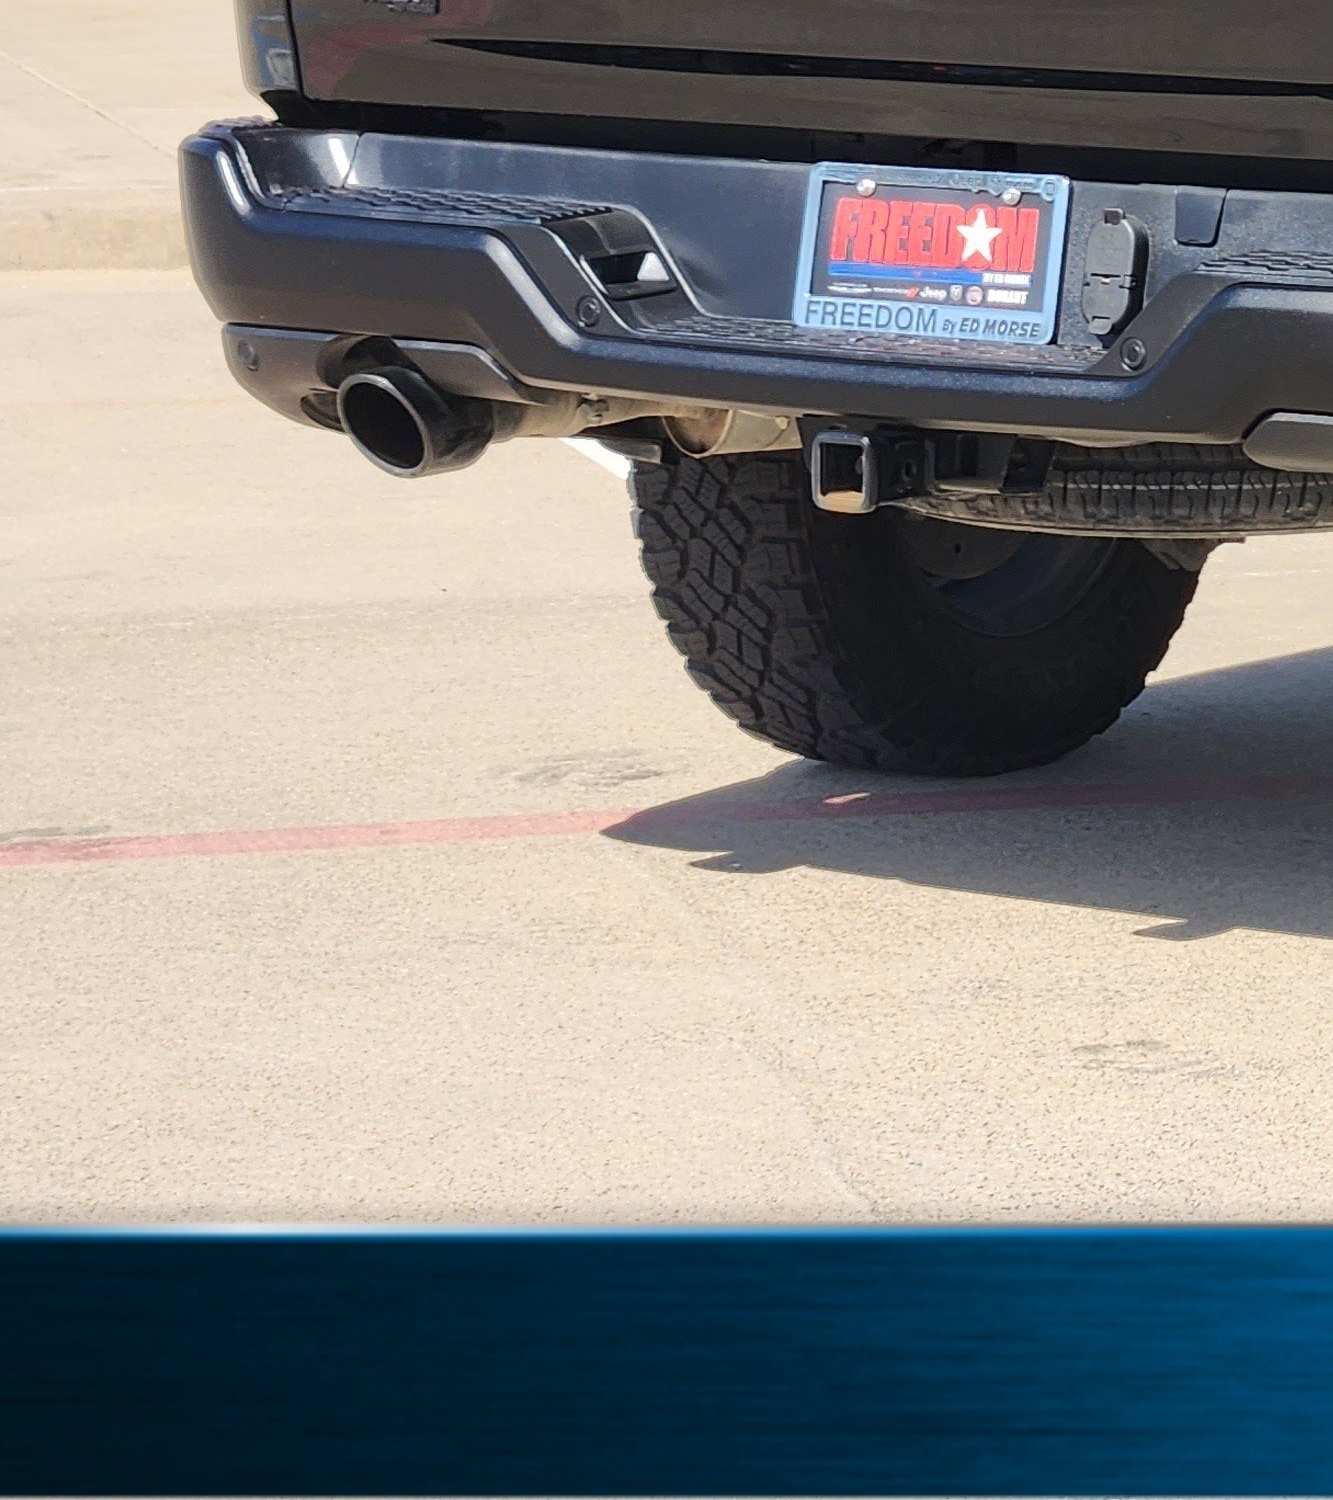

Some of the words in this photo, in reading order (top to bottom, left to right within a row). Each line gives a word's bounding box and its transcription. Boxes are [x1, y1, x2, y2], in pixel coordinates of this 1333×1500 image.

[830, 197, 1040, 273] FREEDOM
[804, 300, 938, 333] FREEDOM
[958, 317, 981, 334] ED
[982, 319, 1041, 339] MORSE
